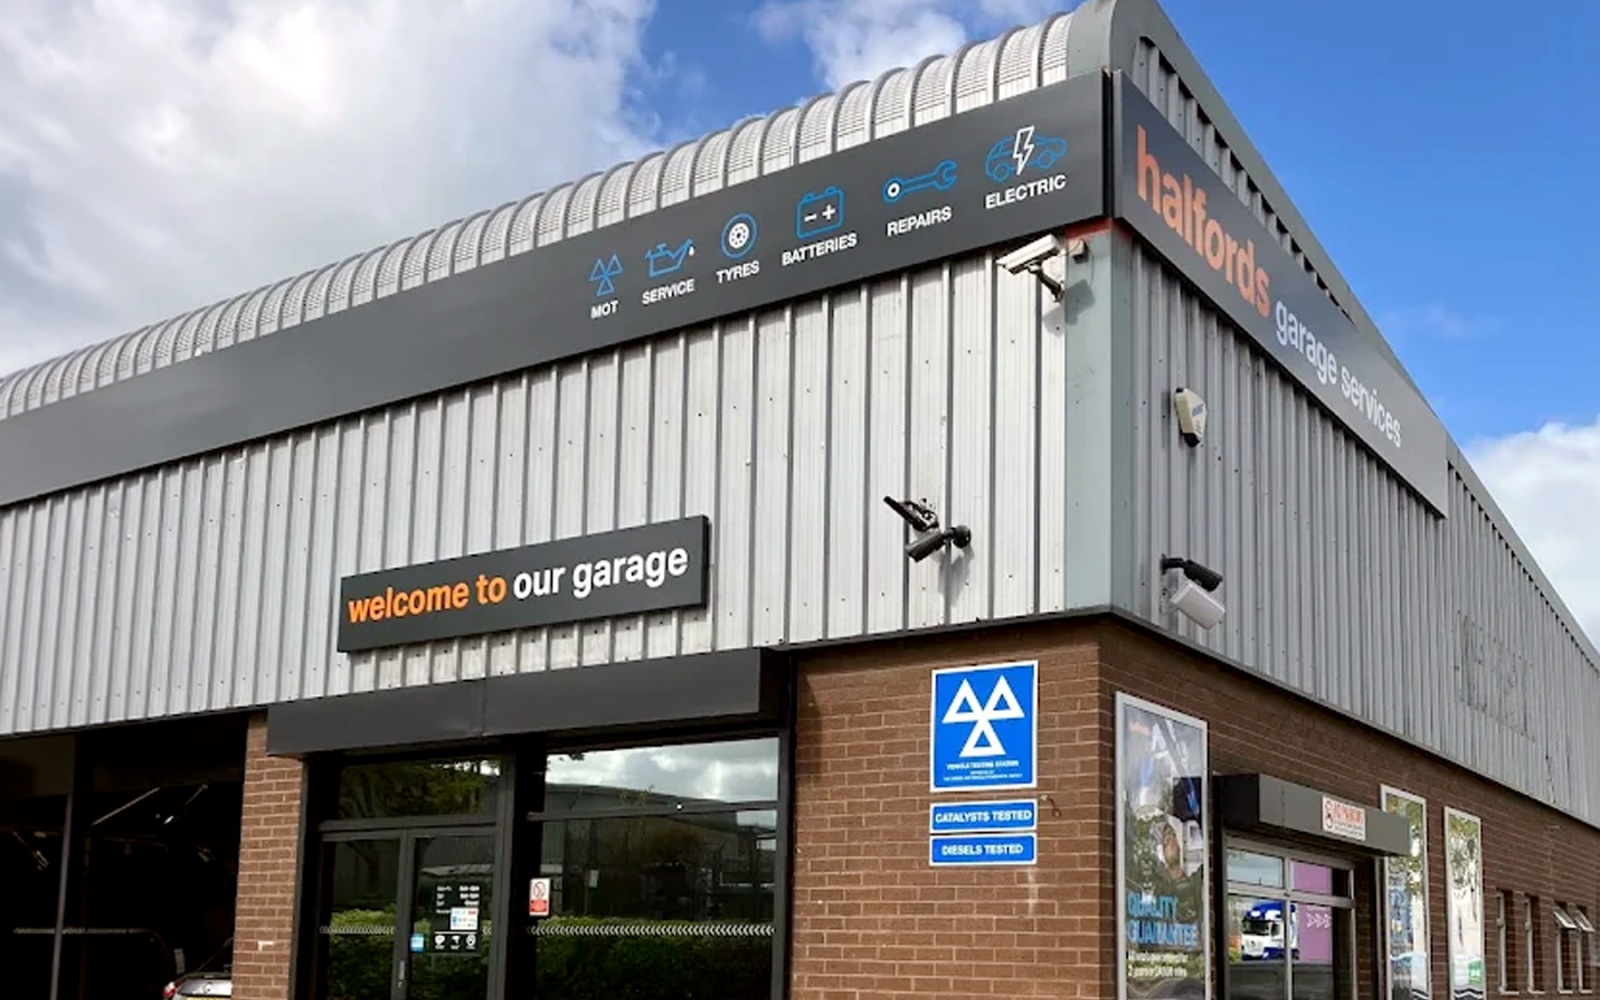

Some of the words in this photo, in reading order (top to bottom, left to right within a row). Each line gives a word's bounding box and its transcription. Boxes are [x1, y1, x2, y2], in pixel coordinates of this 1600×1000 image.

[985, 174, 1067, 209] ELECTRIC
[886, 205, 952, 237] REPAIRS
[781, 232, 858, 267] BATTERIES
[715, 260, 761, 284] TYRES
[1136, 124, 1271, 318] halfords
[1274, 299, 1338, 386] garage
[1340, 365, 1402, 448] services
[641, 278, 696, 306] SERVICE
[590, 299, 619, 319] MOT
[347, 580, 470, 624] welcome
[475, 573, 508, 605] to
[512, 566, 566, 600] our
[571, 547, 690, 600] garage
[935, 810, 991, 824] CATALYSTS
[992, 809, 1033, 822] TESTED
[941, 844, 983, 857] DIESELS
[983, 843, 1025, 856] TESTED
[1127, 919, 1198, 948] GUARANTEE
